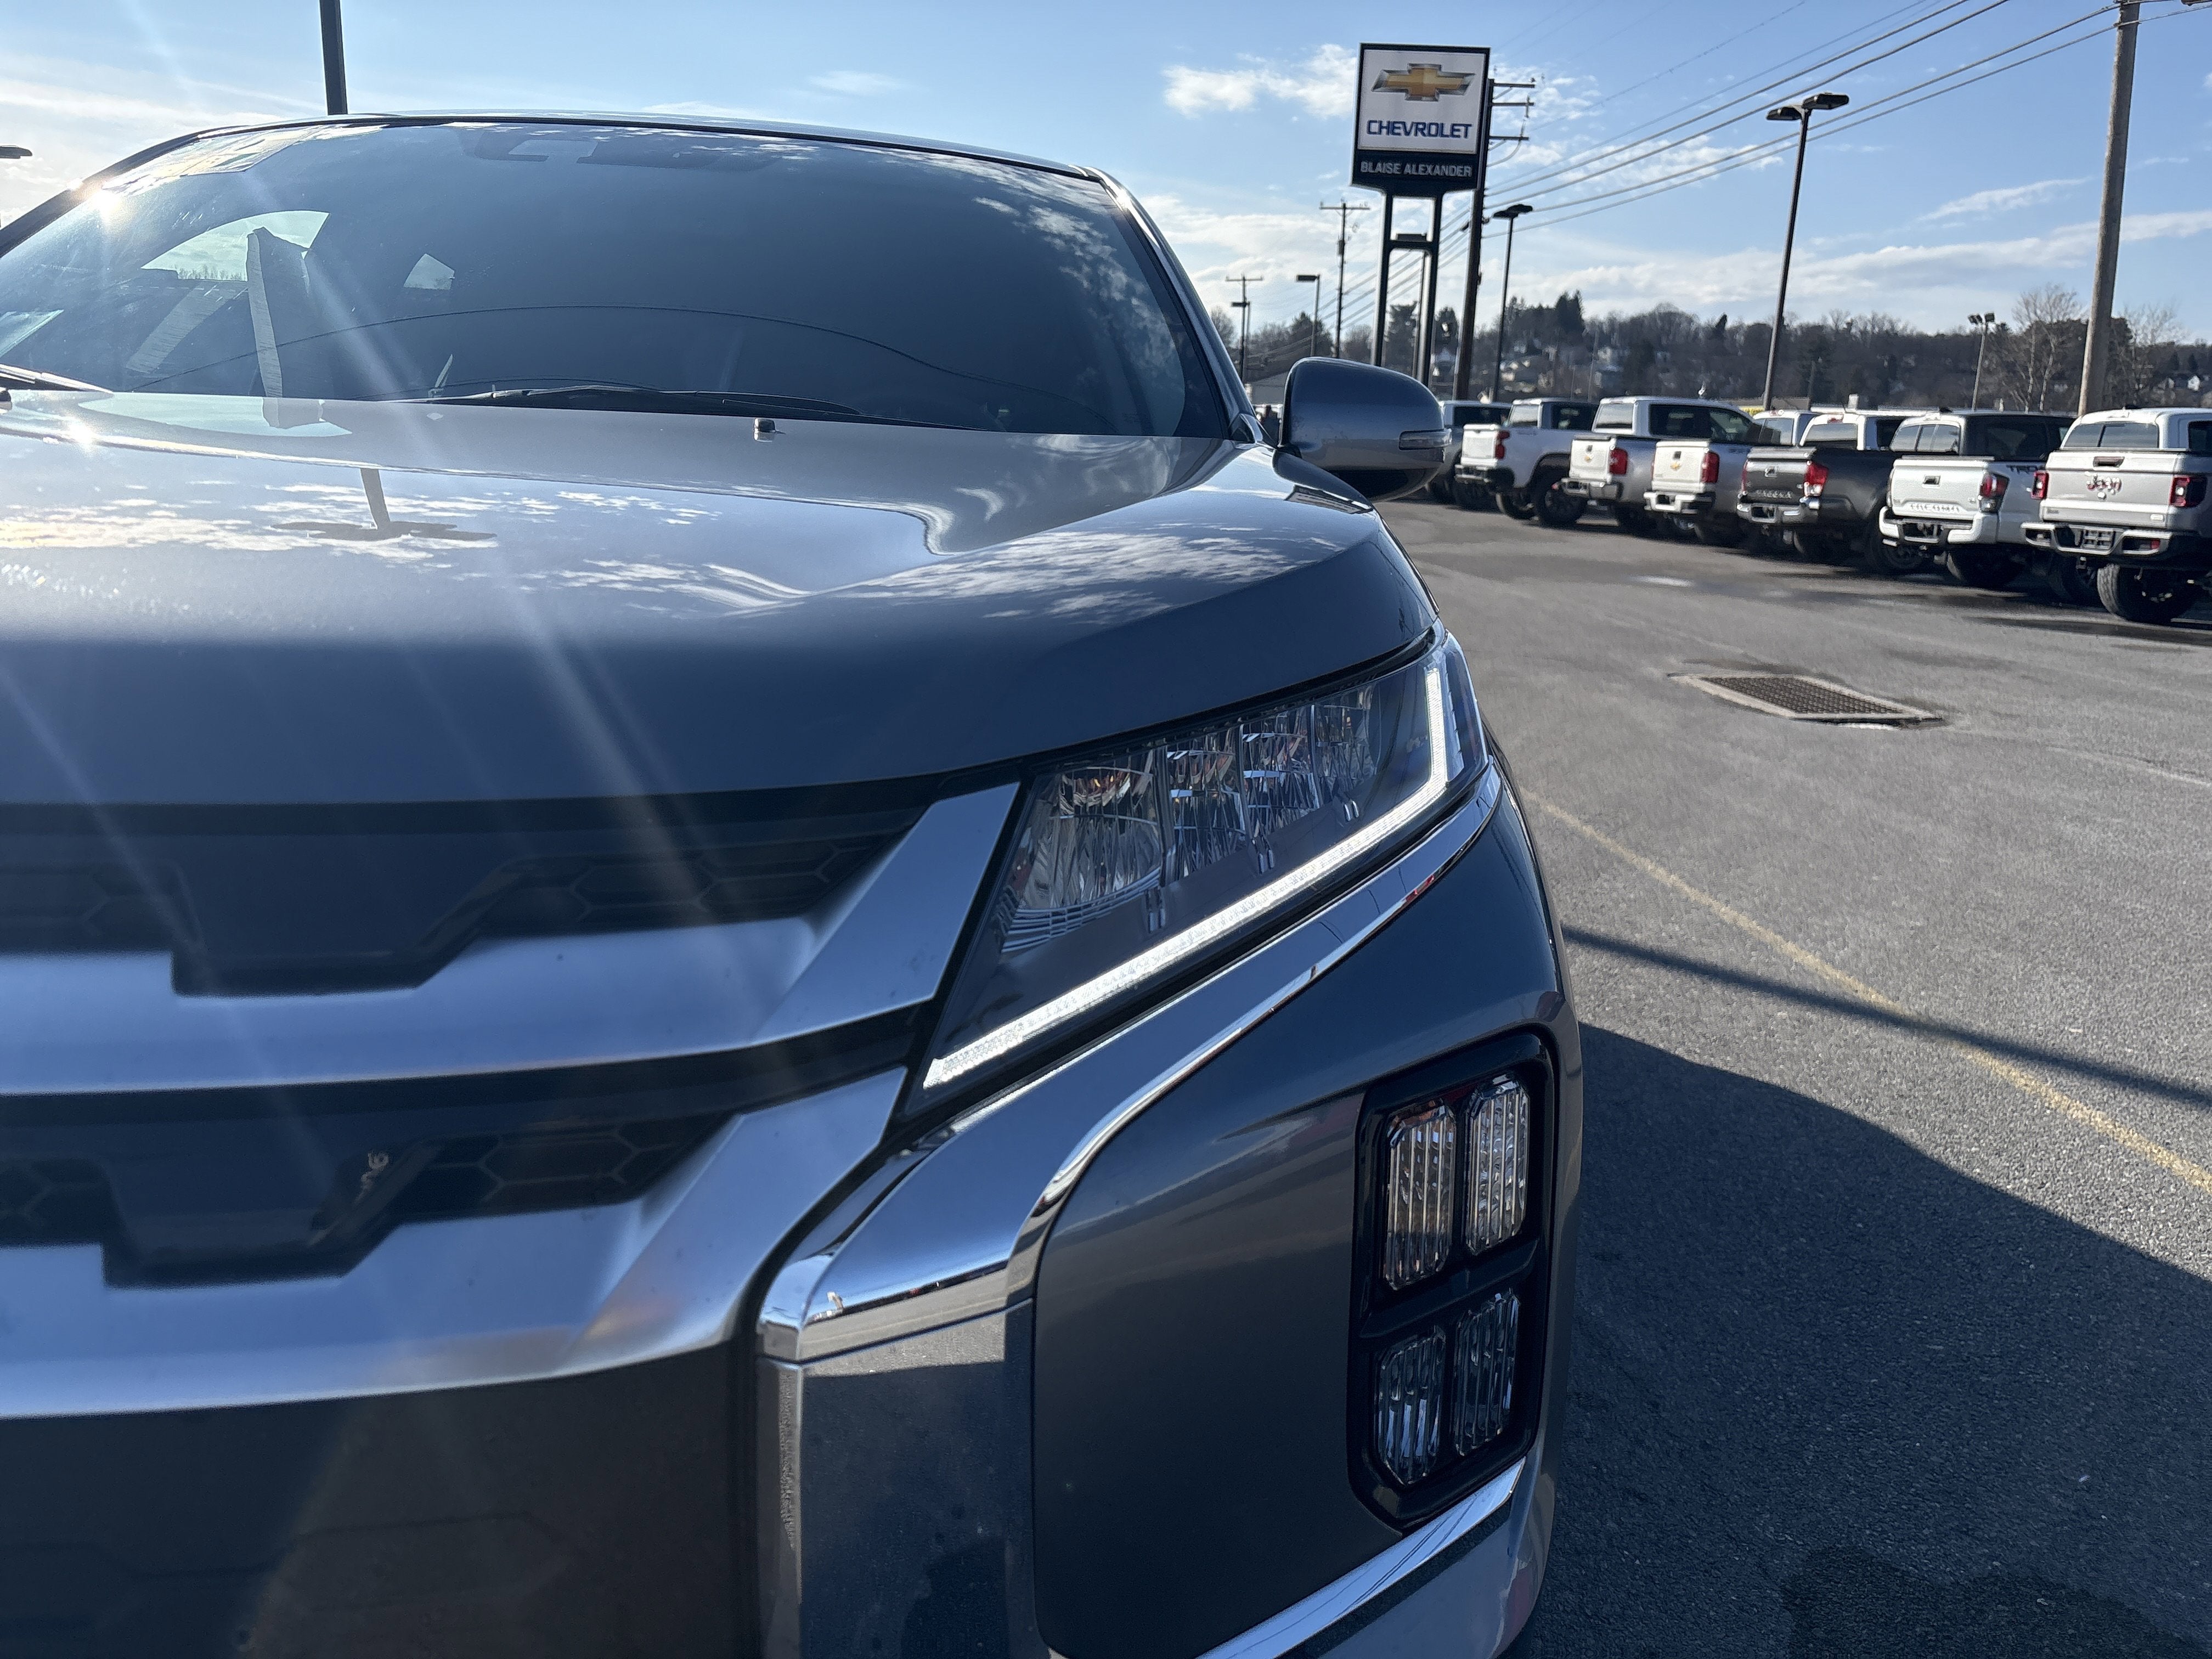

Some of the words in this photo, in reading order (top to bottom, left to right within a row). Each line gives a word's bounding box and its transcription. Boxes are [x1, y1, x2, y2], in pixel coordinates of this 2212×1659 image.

[1367, 120, 1472, 138] CHEVROLET
[1361, 161, 1401, 174] BLAISE
[1403, 162, 1472, 177] ALEXANDER
